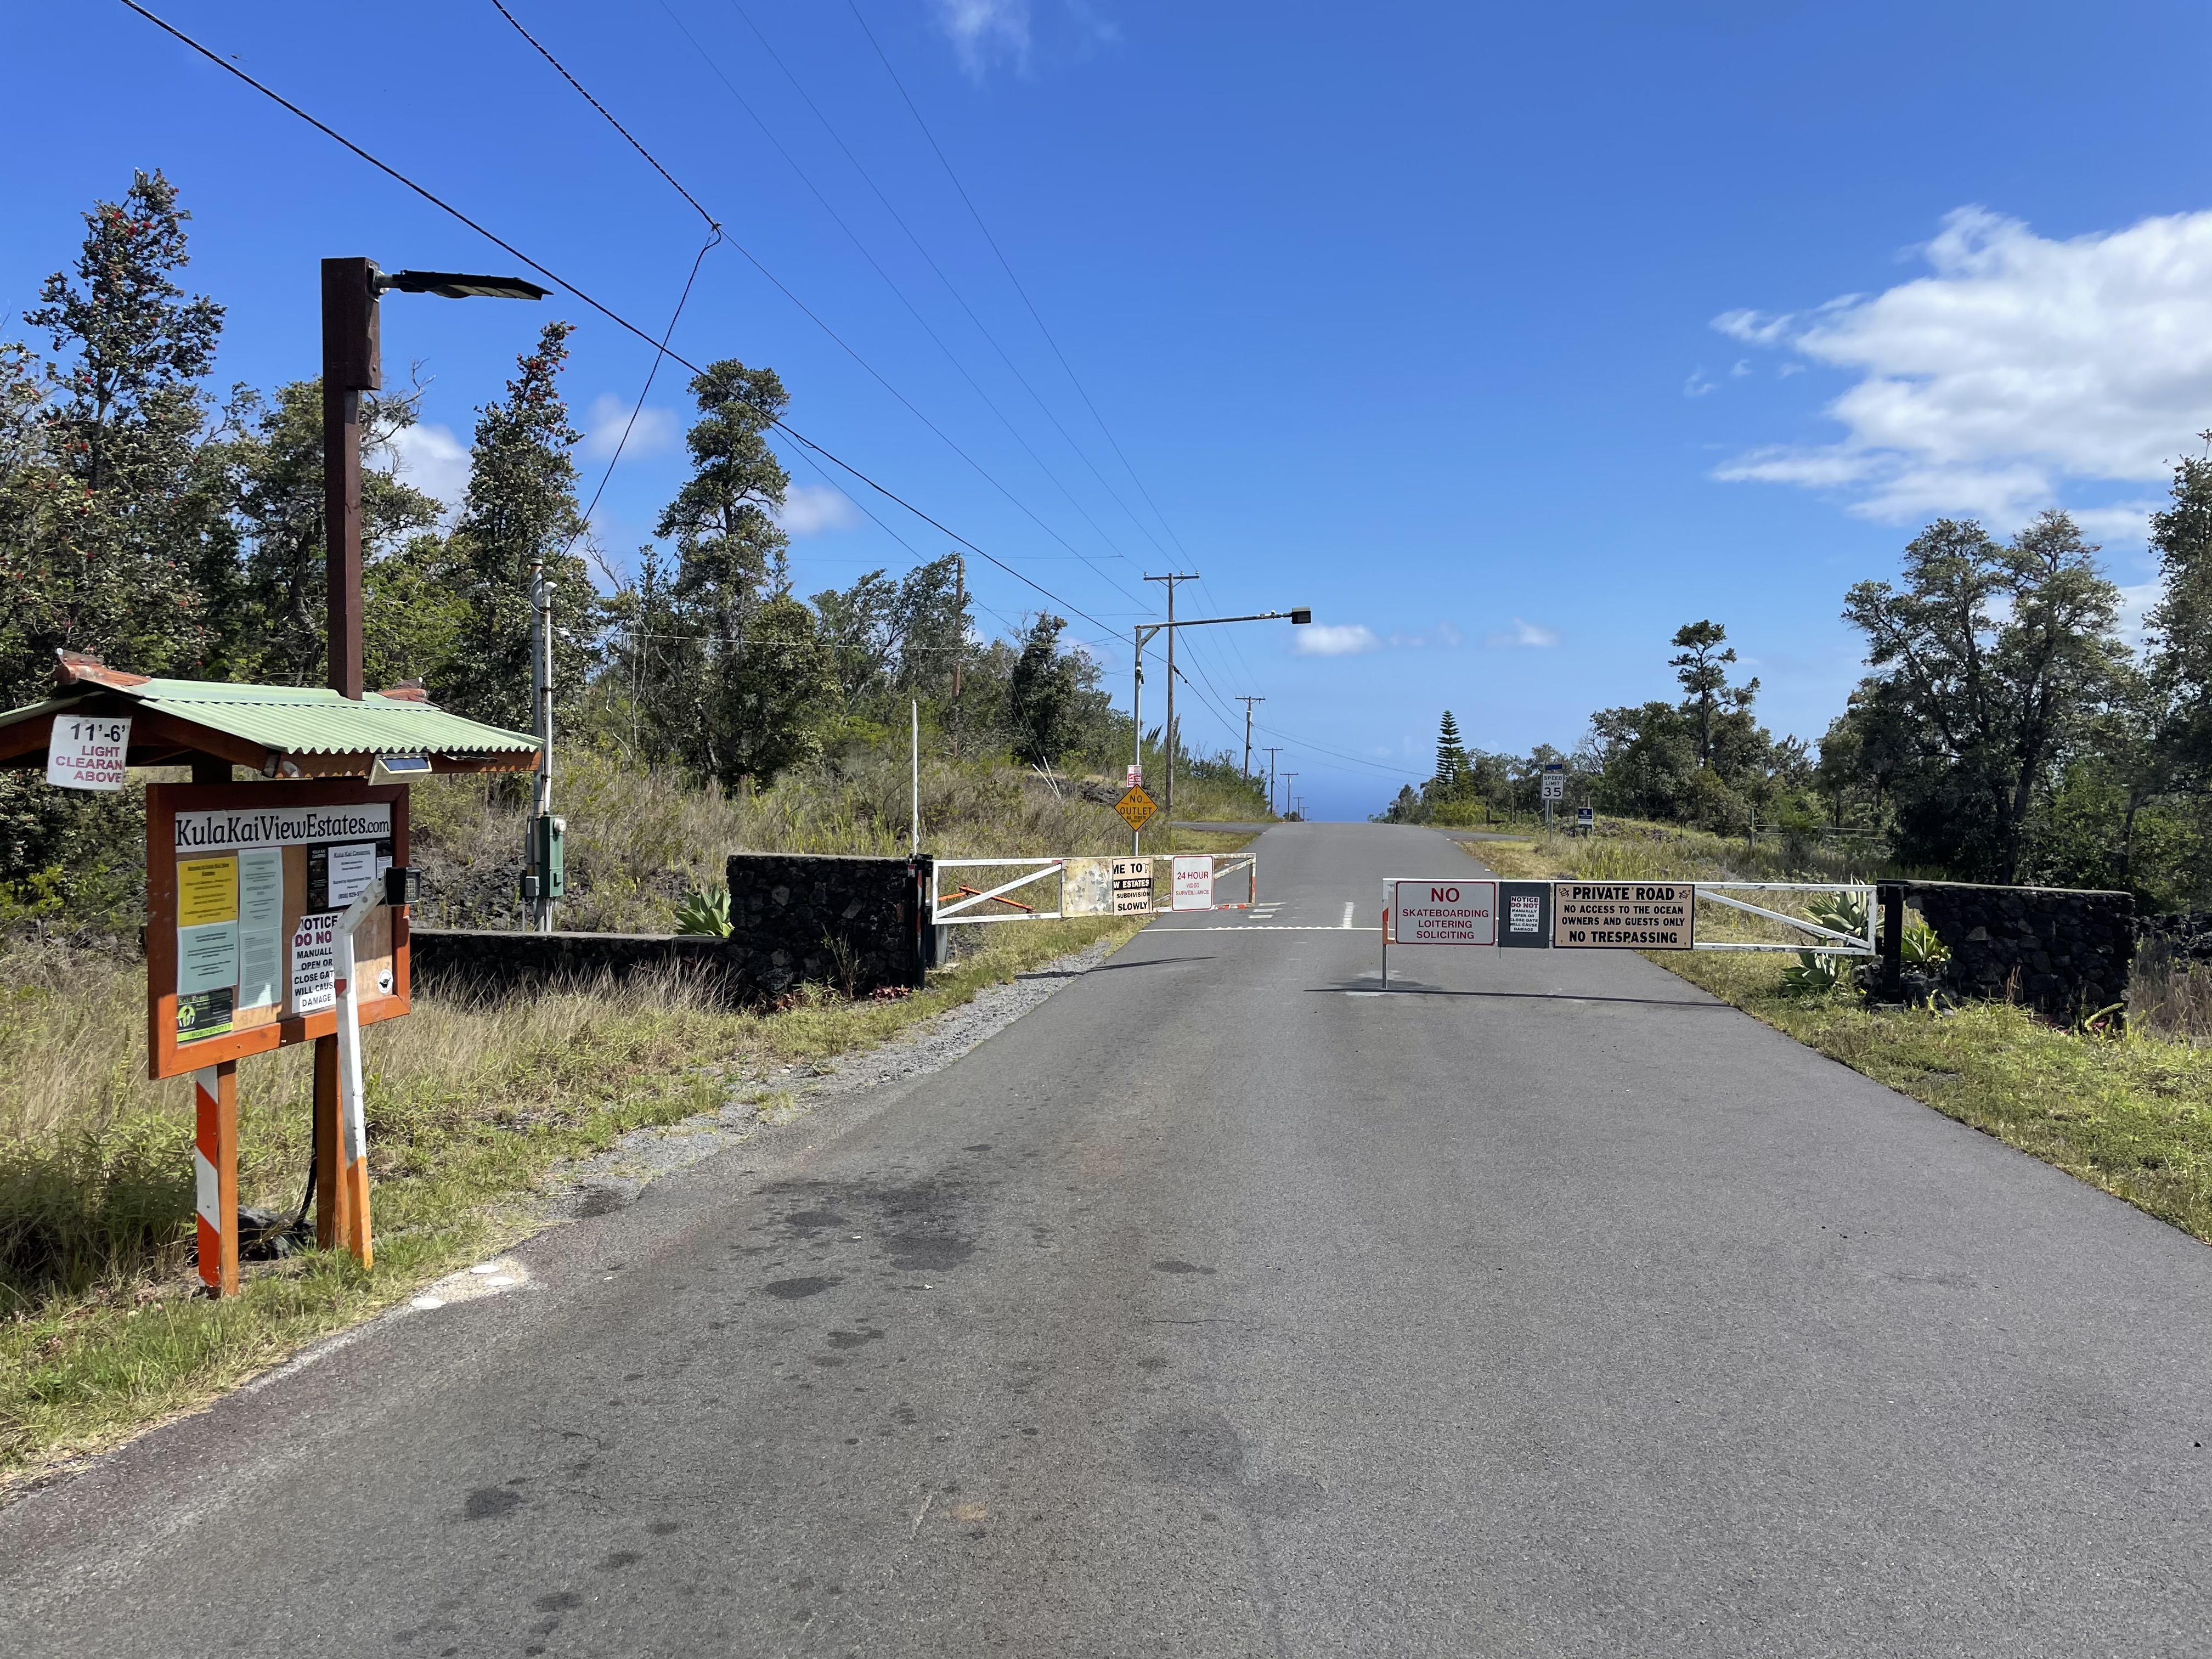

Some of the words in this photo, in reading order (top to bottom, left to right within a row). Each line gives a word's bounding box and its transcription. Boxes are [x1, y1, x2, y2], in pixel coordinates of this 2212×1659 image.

[82, 746, 120, 757] LIGHT
[73, 770, 122, 783] ABOVE
[1544, 787, 1561, 797] 35
[176, 813, 390, 847] KulaKaiViewEstates.com
[1177, 872, 1186, 880] 24
[1188, 871, 1209, 879] HOUR
[1122, 879, 1149, 888] ESTATES
[1431, 888, 1460, 902] NO
[1573, 887, 1630, 900] PRIVATE
[1636, 887, 1675, 901] ROAD
[1118, 901, 1148, 911] SLOWLY
[1564, 905, 1576, 913] NO
[1579, 905, 1615, 914] ACCESS
[1619, 905, 1630, 914] TO
[1633, 905, 1650, 915] THE
[1654, 906, 1684, 915] OCEAN
[1402, 909, 1489, 918] SKATEBOARDING
[1418, 919, 1472, 928] LOITERING
[1561, 917, 1600, 926] OWNERS
[1603, 917, 1621, 926] AND
[1625, 917, 1660, 926] GUESTS
[1663, 917, 1685, 927] ONLY
[295, 933, 312, 947] DO
[316, 930, 332, 945] NO
[1417, 930, 1475, 939] SOLICITING
[1569, 930, 1585, 943] NO
[1591, 931, 1678, 944] TRESPASSING
[297, 947, 332, 959] MANUALL
[301, 960, 321, 970] OPEN
[323, 958, 333, 967] OR
[295, 973, 318, 985] CLOSE
[320, 970, 334, 980] GAT
[295, 986, 313, 997] WILL
[315, 982, 333, 992] CAUS
[302, 994, 331, 1007] DAMAGE
